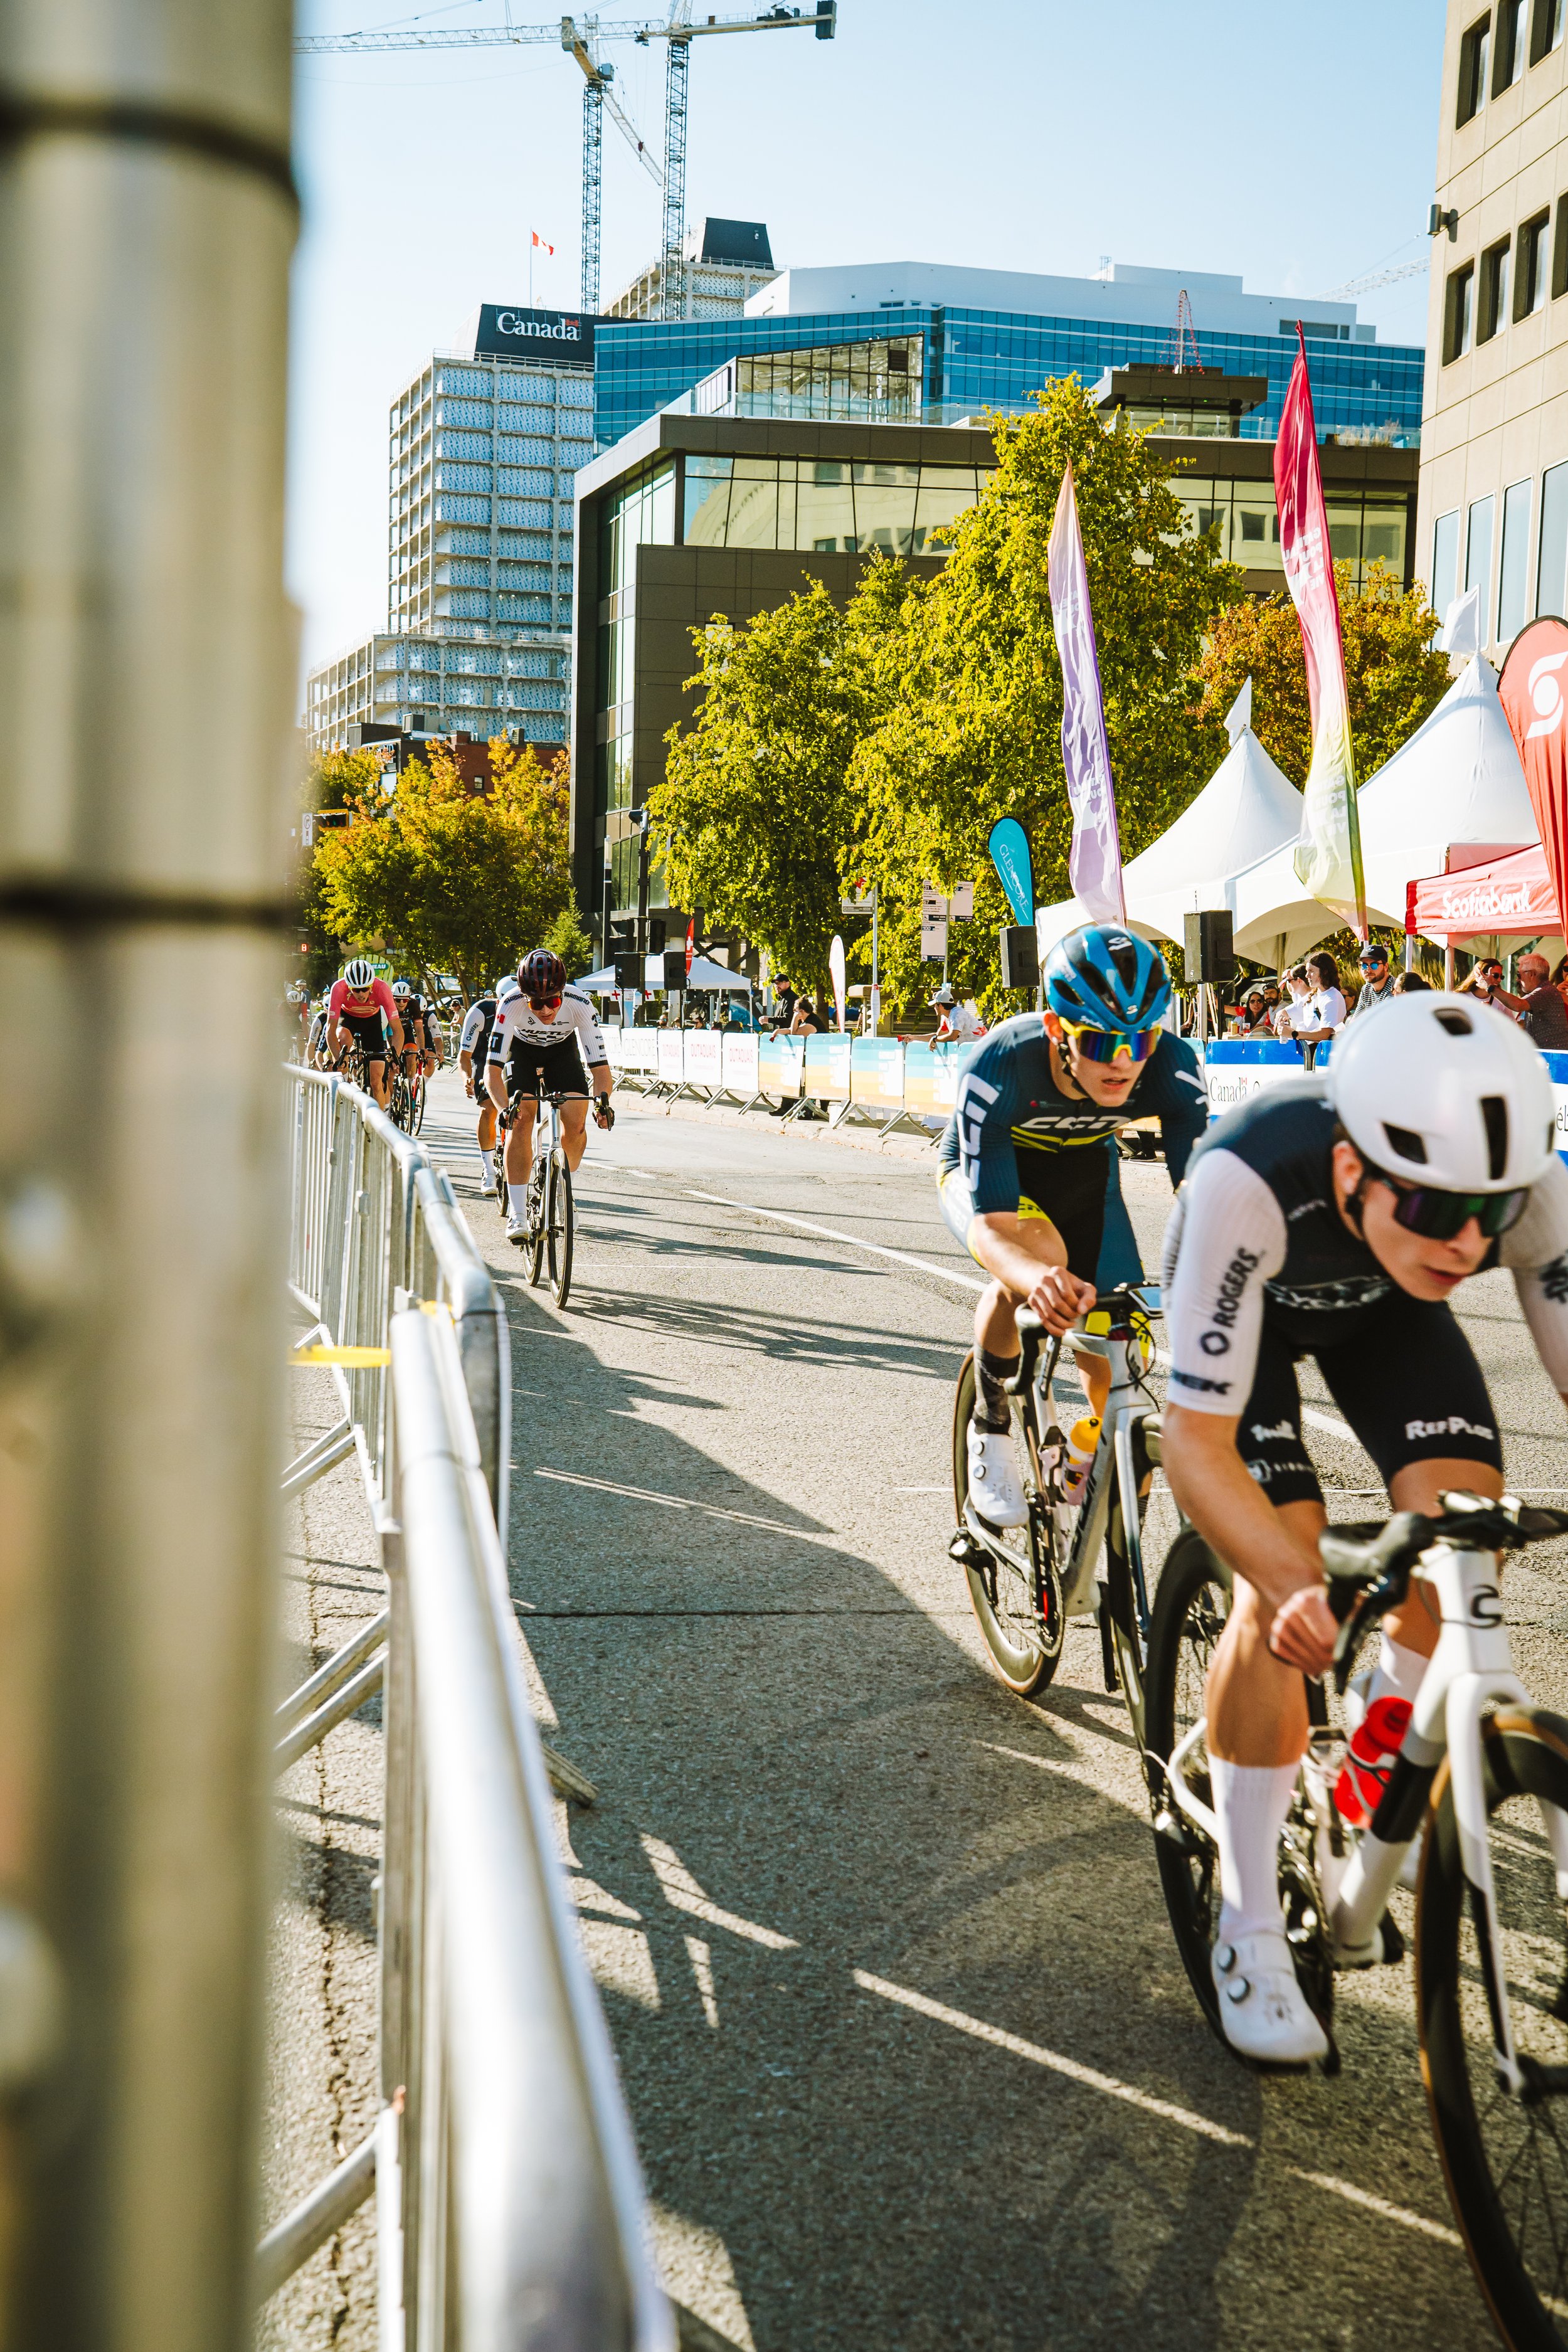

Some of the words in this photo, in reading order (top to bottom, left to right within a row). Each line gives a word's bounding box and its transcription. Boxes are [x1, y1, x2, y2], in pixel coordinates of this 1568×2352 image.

[497, 312, 580, 341] Canada
[1441, 883, 1532, 919] Scotiabank
[691, 1044, 716, 1059] OUTAOUAIS
[1210, 1076, 1247, 1102] Canada
[1212, 1246, 1258, 1328] ROGERS
